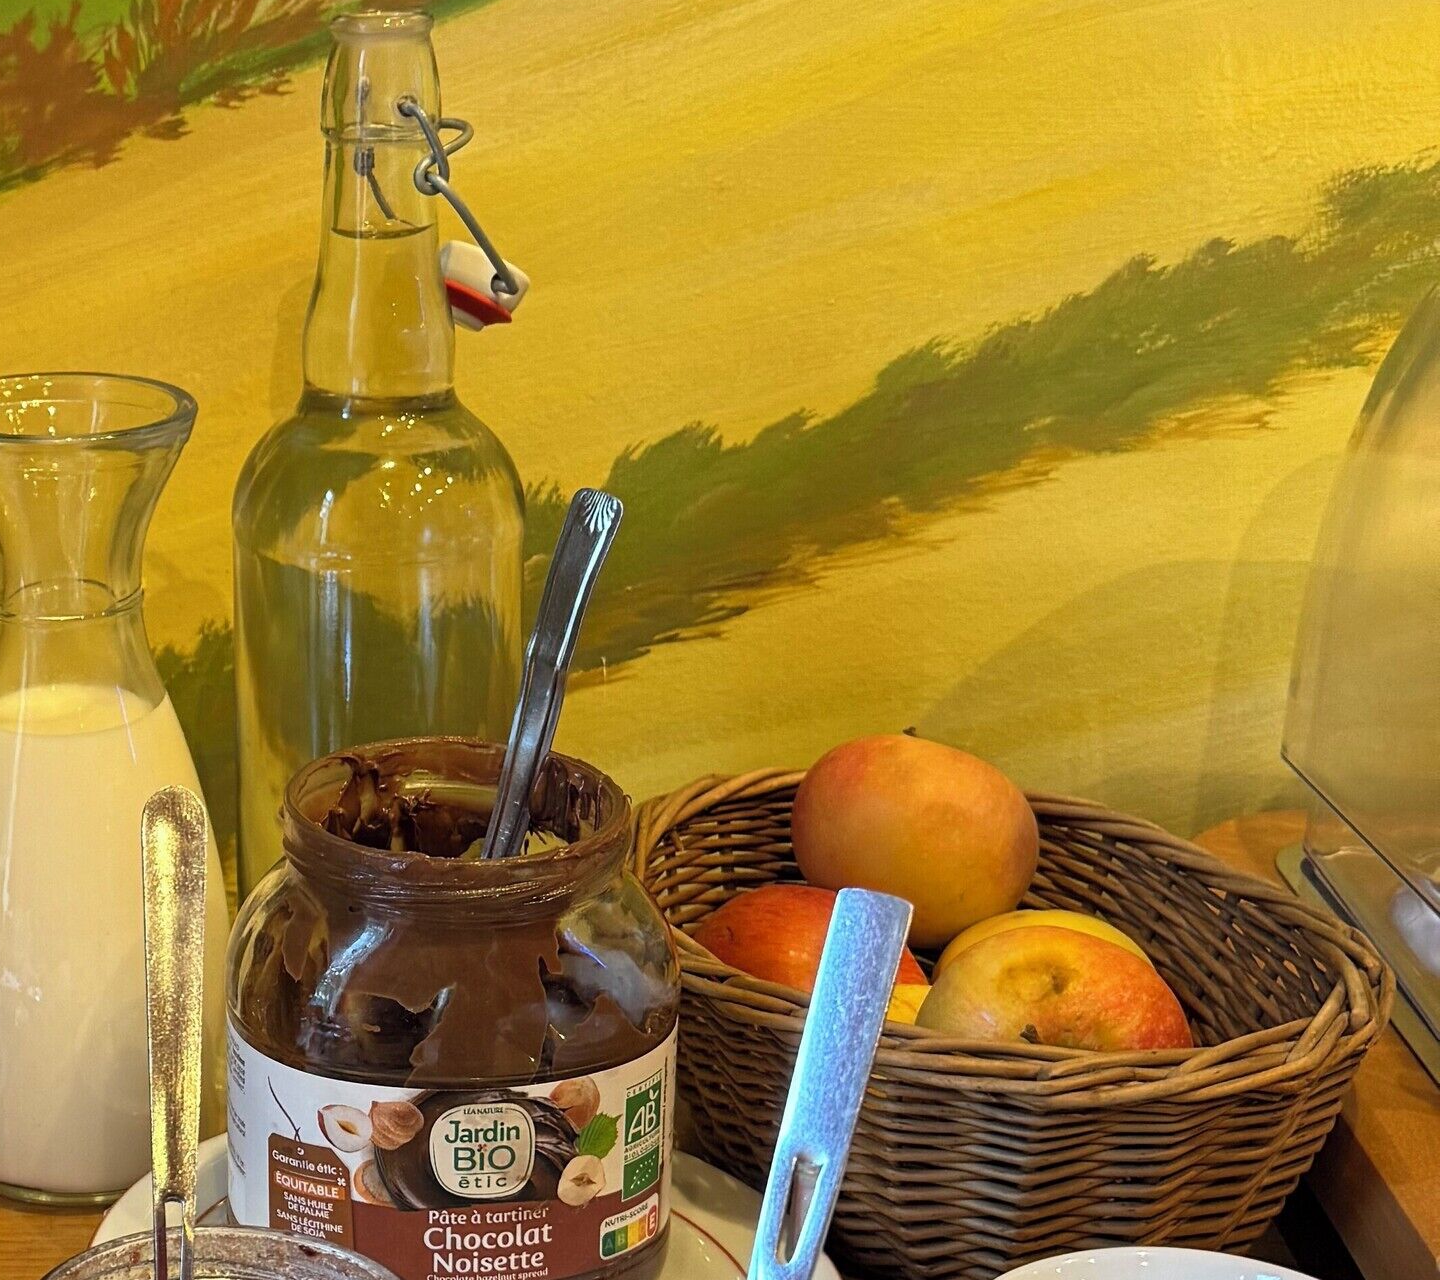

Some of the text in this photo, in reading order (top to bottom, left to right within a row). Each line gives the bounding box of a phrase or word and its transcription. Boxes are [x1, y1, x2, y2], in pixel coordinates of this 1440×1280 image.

[477, 1107, 504, 1115] NATURE
[444, 1120, 520, 1143] Jardin
[627, 1100, 656, 1143] AB
[275, 1170, 339, 1198] ÉQUITABLE
[283, 1191, 333, 1211] SANS HUILE
[288, 1201, 329, 1219] DE PALME
[276, 1208, 343, 1233] SANS LÉCITHINE
[428, 1207, 549, 1224] Pâte à tartiner
[649, 1212, 656, 1229] E
[291, 1222, 326, 1239] DE SOJA
[423, 1223, 553, 1250] Chocolat
[433, 1251, 545, 1273] Noisette
[517, 1267, 548, 1280] spread
